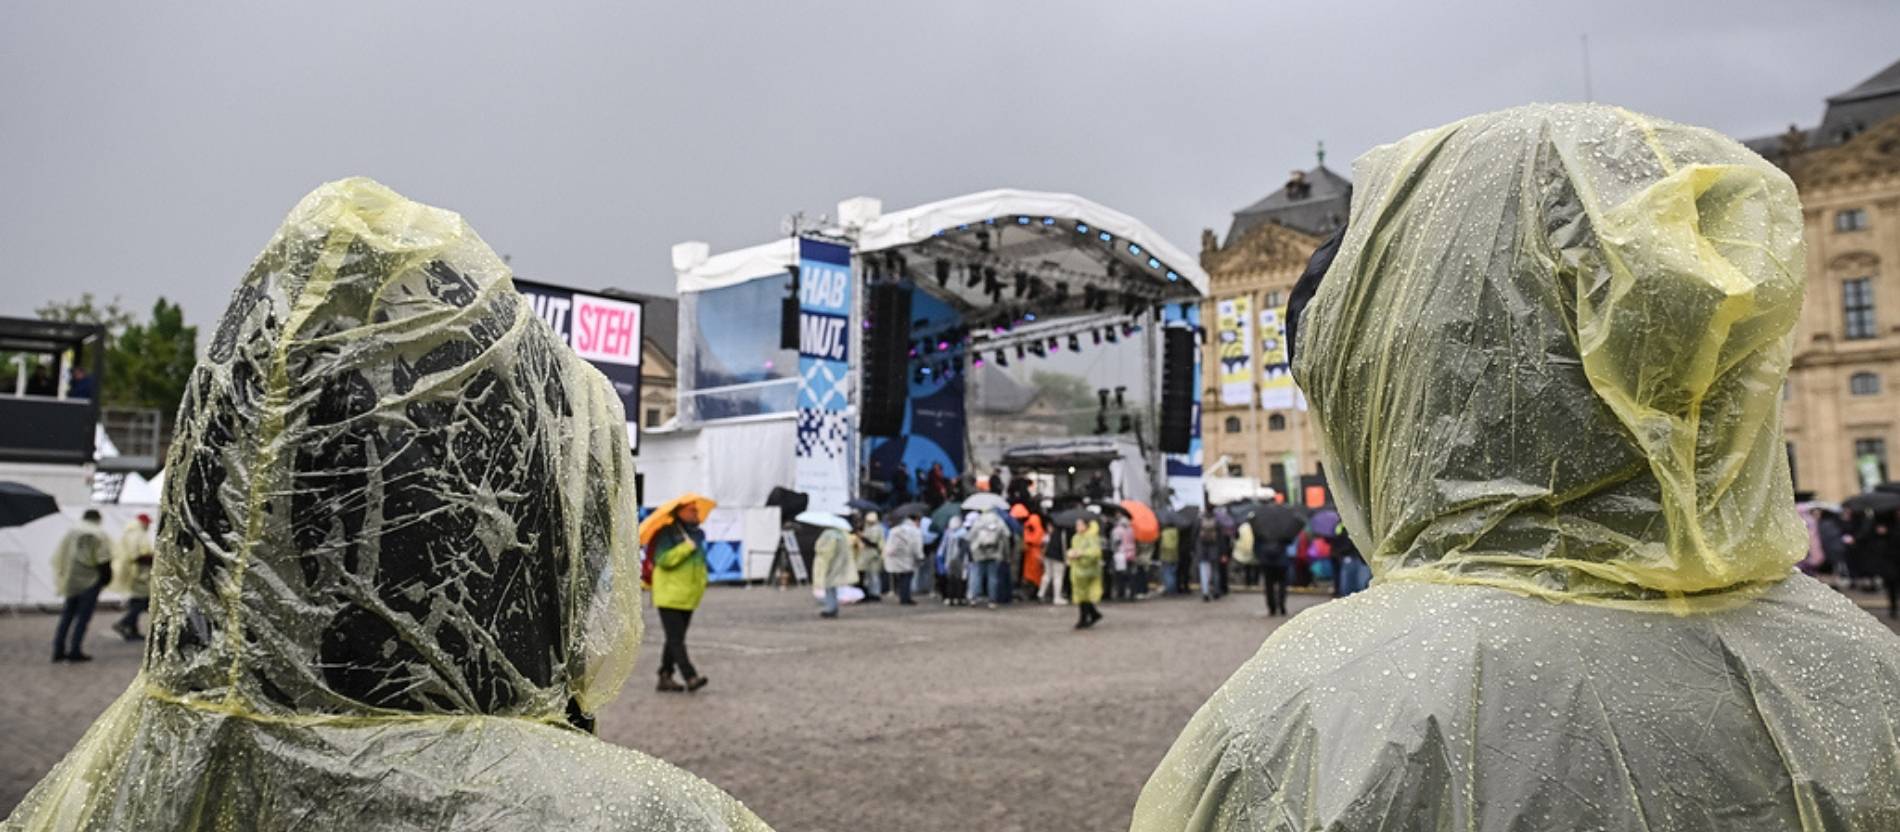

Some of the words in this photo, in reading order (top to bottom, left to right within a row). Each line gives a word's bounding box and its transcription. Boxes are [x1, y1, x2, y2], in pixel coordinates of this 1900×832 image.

[801, 266, 846, 309] HAB
[578, 302, 635, 357] STEH
[800, 313, 846, 360] MUT,
